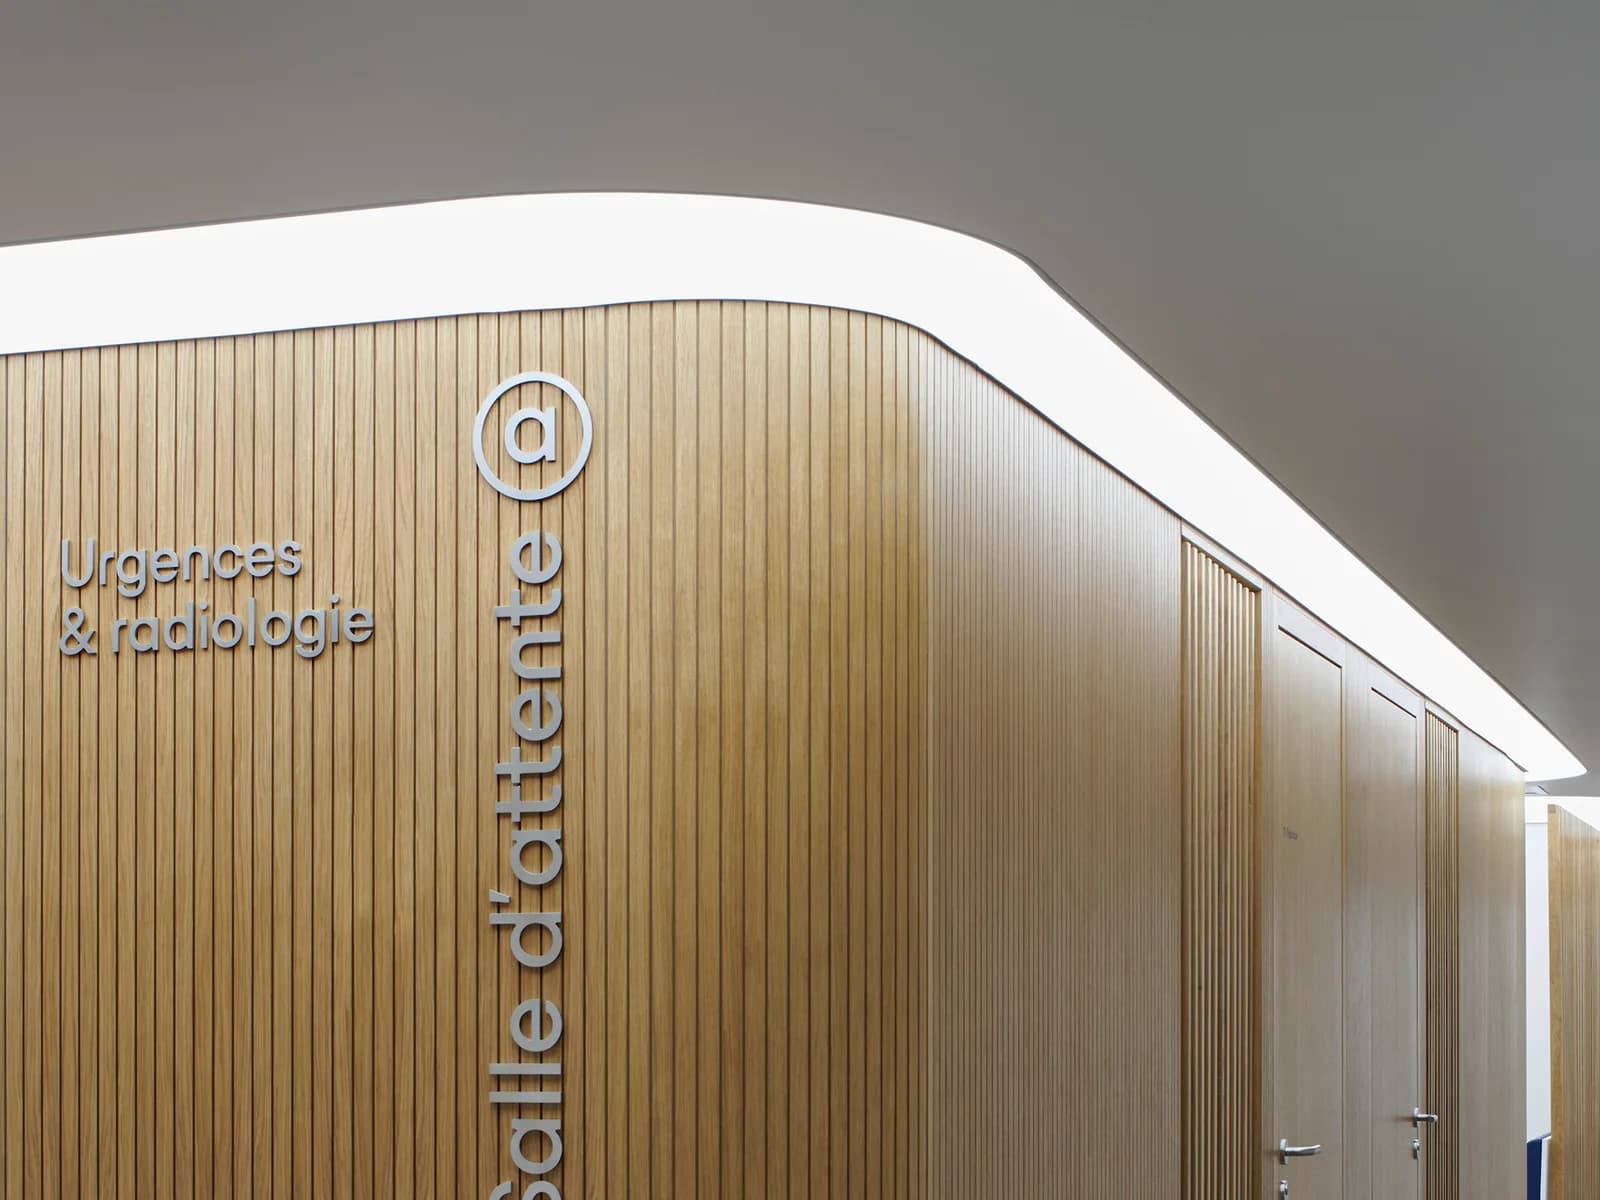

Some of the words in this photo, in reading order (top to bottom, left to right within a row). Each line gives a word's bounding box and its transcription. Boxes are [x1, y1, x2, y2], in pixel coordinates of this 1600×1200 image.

[61, 537, 303, 598] Urgences
[59, 607, 97, 656] &
[111, 593, 375, 659] radiologie
[488, 530, 563, 967] d'attente
